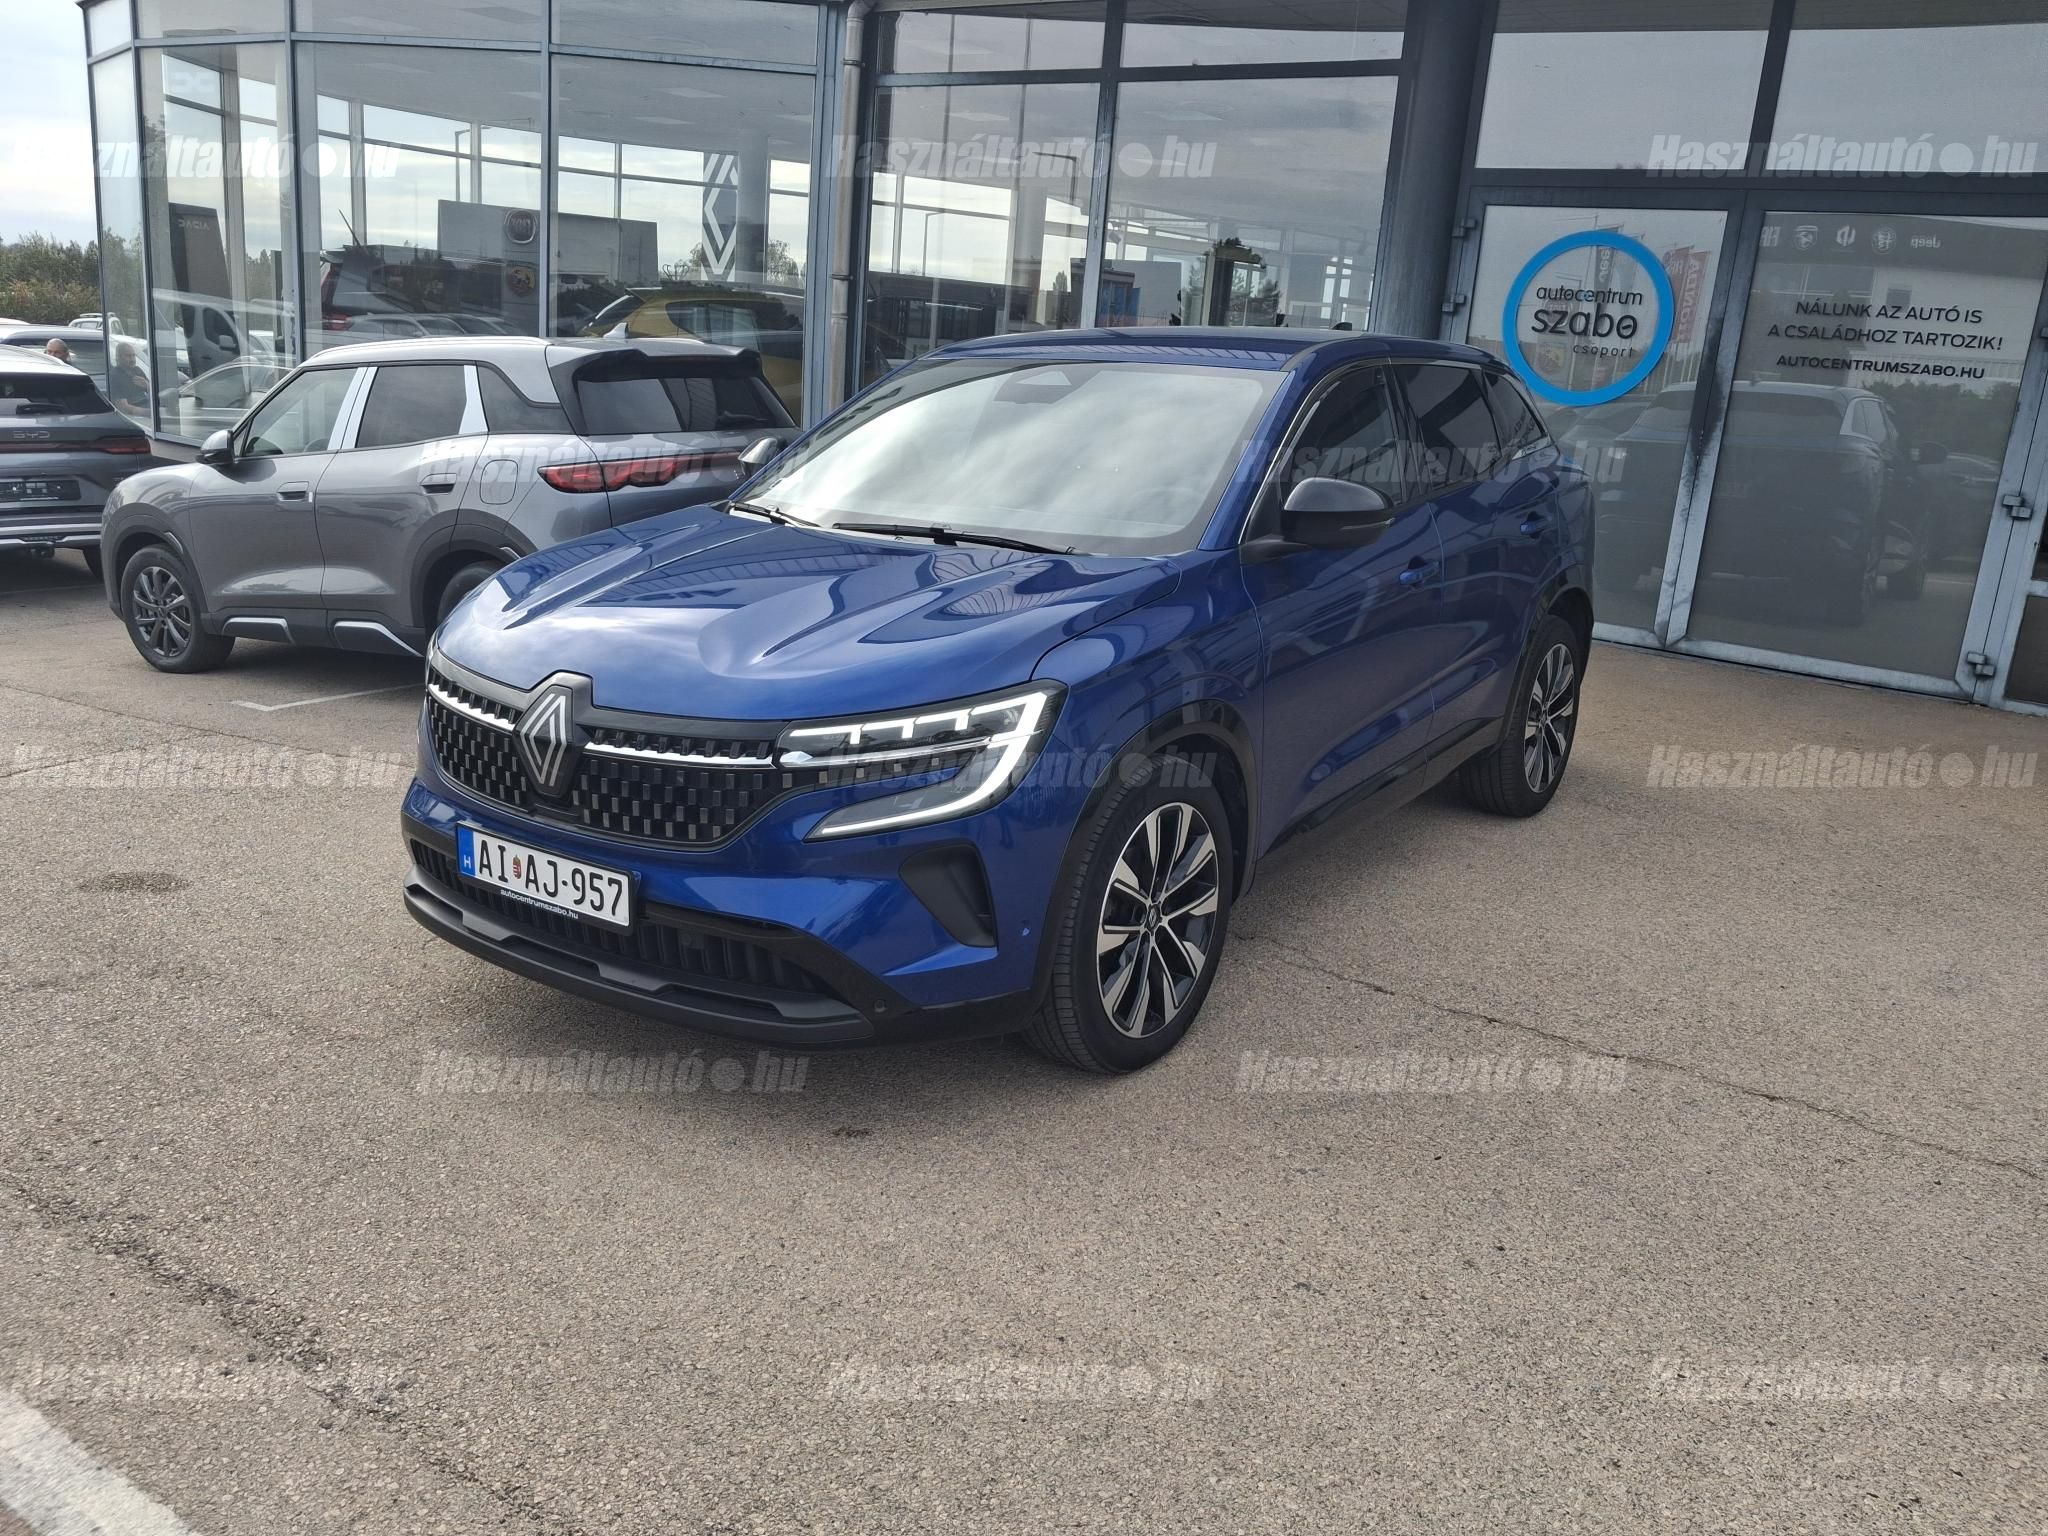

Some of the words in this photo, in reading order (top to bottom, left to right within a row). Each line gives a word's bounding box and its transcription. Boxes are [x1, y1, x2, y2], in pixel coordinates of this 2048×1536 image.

[1536, 285, 1643, 305] autocentrum
[1796, 298, 1872, 317] NÁLUNK
[1876, 304, 1900, 319] AZ
[1905, 305, 1960, 322] AUTÓ
[1965, 310, 1983, 324] IS
[1768, 324, 1780, 337] A
[1785, 322, 1897, 344] CSALÁDHOZ
[1903, 331, 2003, 350] TARTOZIK!
[1573, 344, 1633, 358] csoport
[1777, 355, 1985, 379] AUTOCENTRUMSZABO.HU
[13, 431, 50, 439] BYD
[463, 855, 471, 869] H
[479, 840, 508, 883] AI
[525, 854, 622, 917] AJ-957
[500, 889, 578, 919] autocentrumszabo.hu
